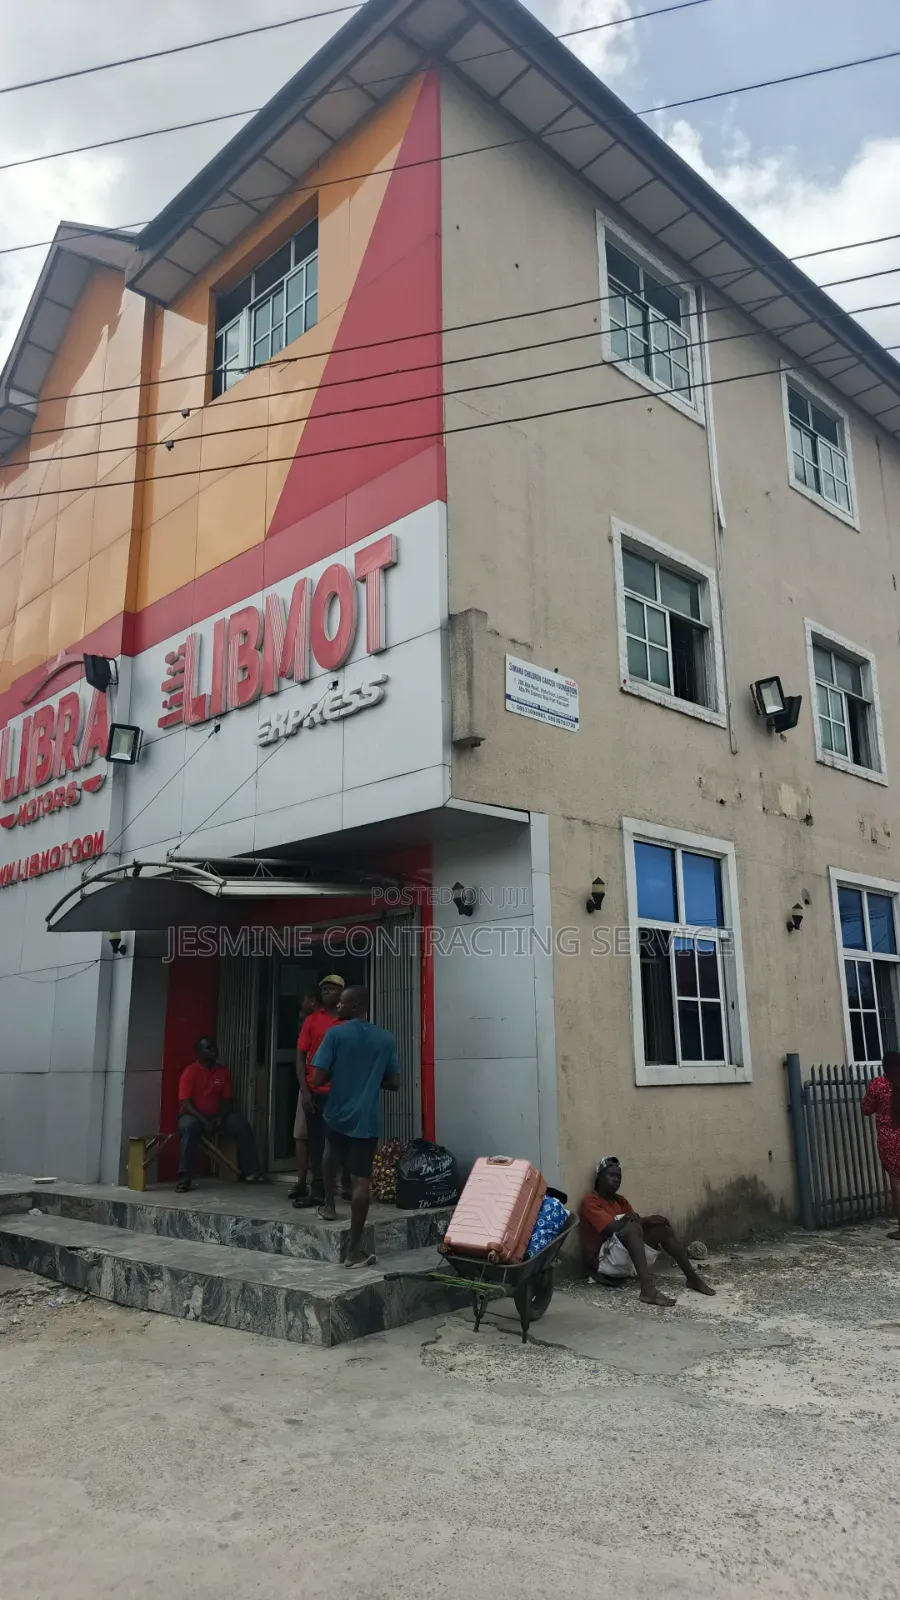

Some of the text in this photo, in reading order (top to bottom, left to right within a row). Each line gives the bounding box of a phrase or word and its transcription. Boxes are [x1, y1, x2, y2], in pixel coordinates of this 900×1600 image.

[182, 533, 398, 726] LIBMOT
[255, 674, 389, 747] EXPRESS
[555, 682, 578, 695] FOUNDATION
[0, 688, 109, 803] LIBRA
[17, 781, 82, 828] MOTORS
